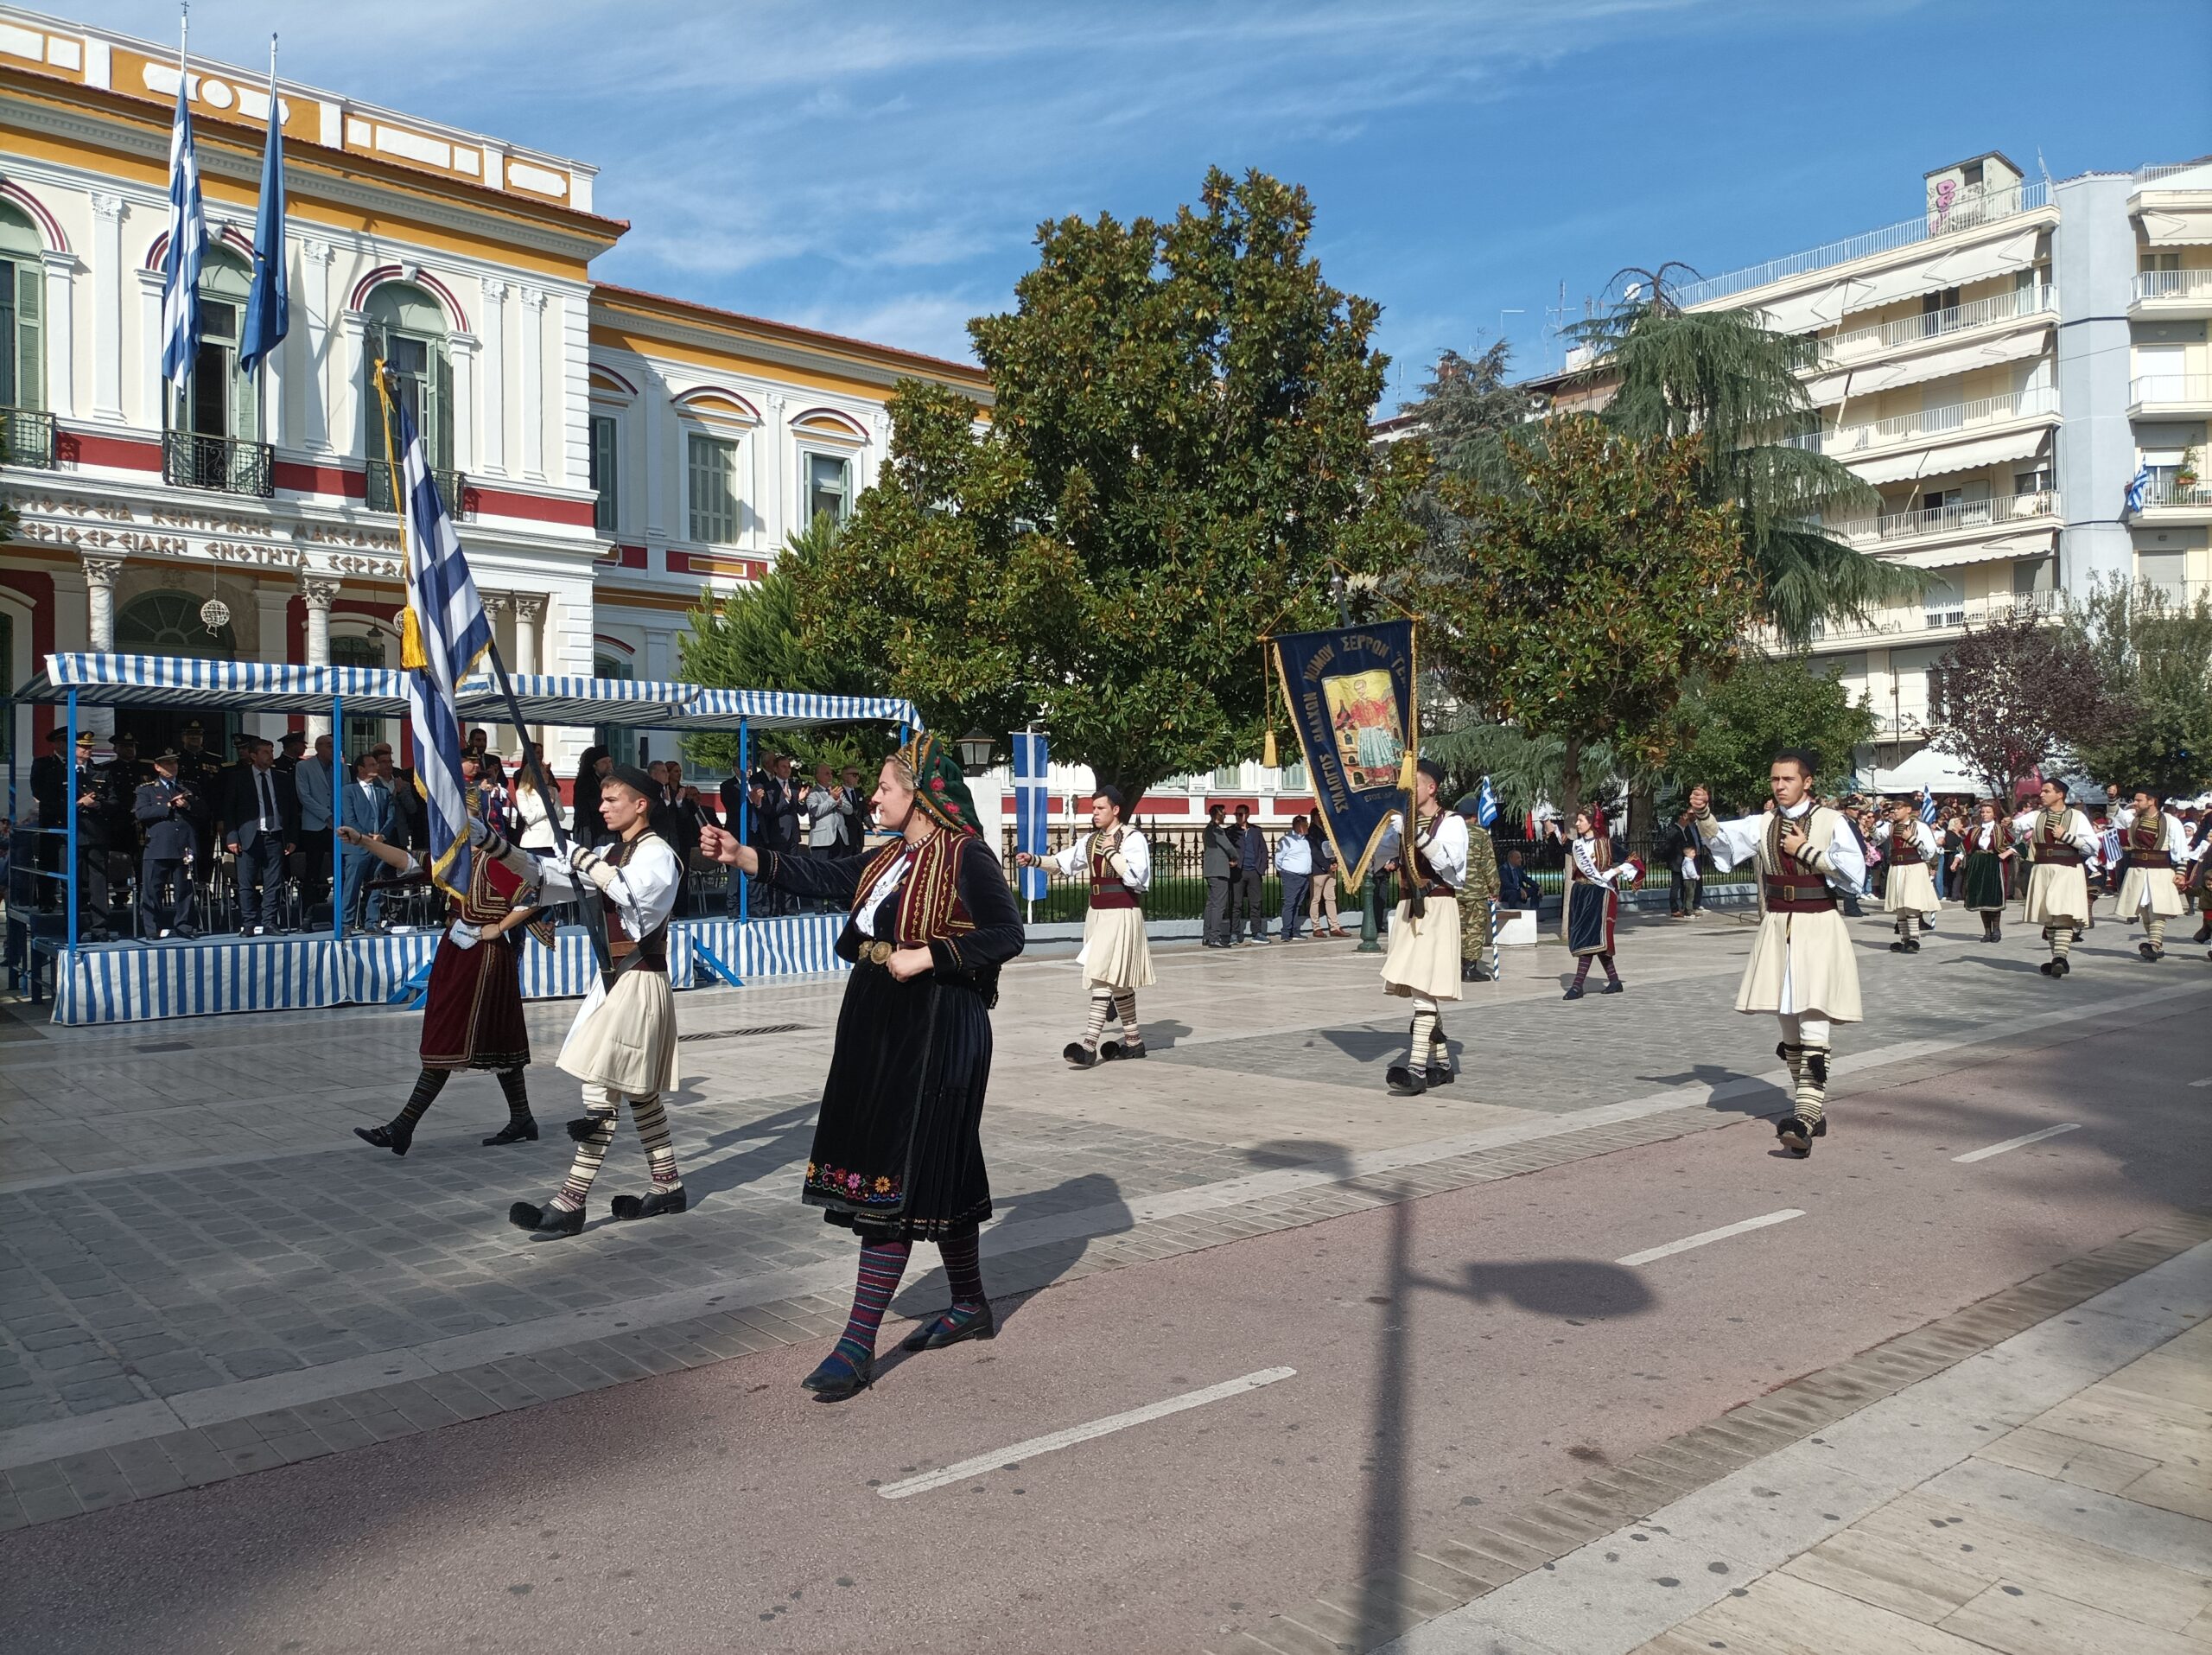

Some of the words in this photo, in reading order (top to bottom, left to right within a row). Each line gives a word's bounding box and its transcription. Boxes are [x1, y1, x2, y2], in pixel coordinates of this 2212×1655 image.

[22, 522, 188, 555] ΕΡΙΦΕΡΕΙΑΚΗ
[204, 541, 311, 568] ΕΝΟΤΗΤΑ
[152, 506, 273, 538] ΚΕΝΤΡΙΚΗΣ
[291, 524, 403, 551] ΜΑΚΕΔΟΝΙ
[1302, 644, 1335, 683] ΝΟΜΟΥ
[1340, 634, 1389, 658] ΣΕΡΡΩΝ
[1303, 691, 1326, 743] ΒΛΑΧΩΝ
[1319, 753, 1349, 814] ΣΥΛΛΟΓΟΣ
[1575, 844, 1596, 877] ΣΥΛΛΟΓΟΣ
